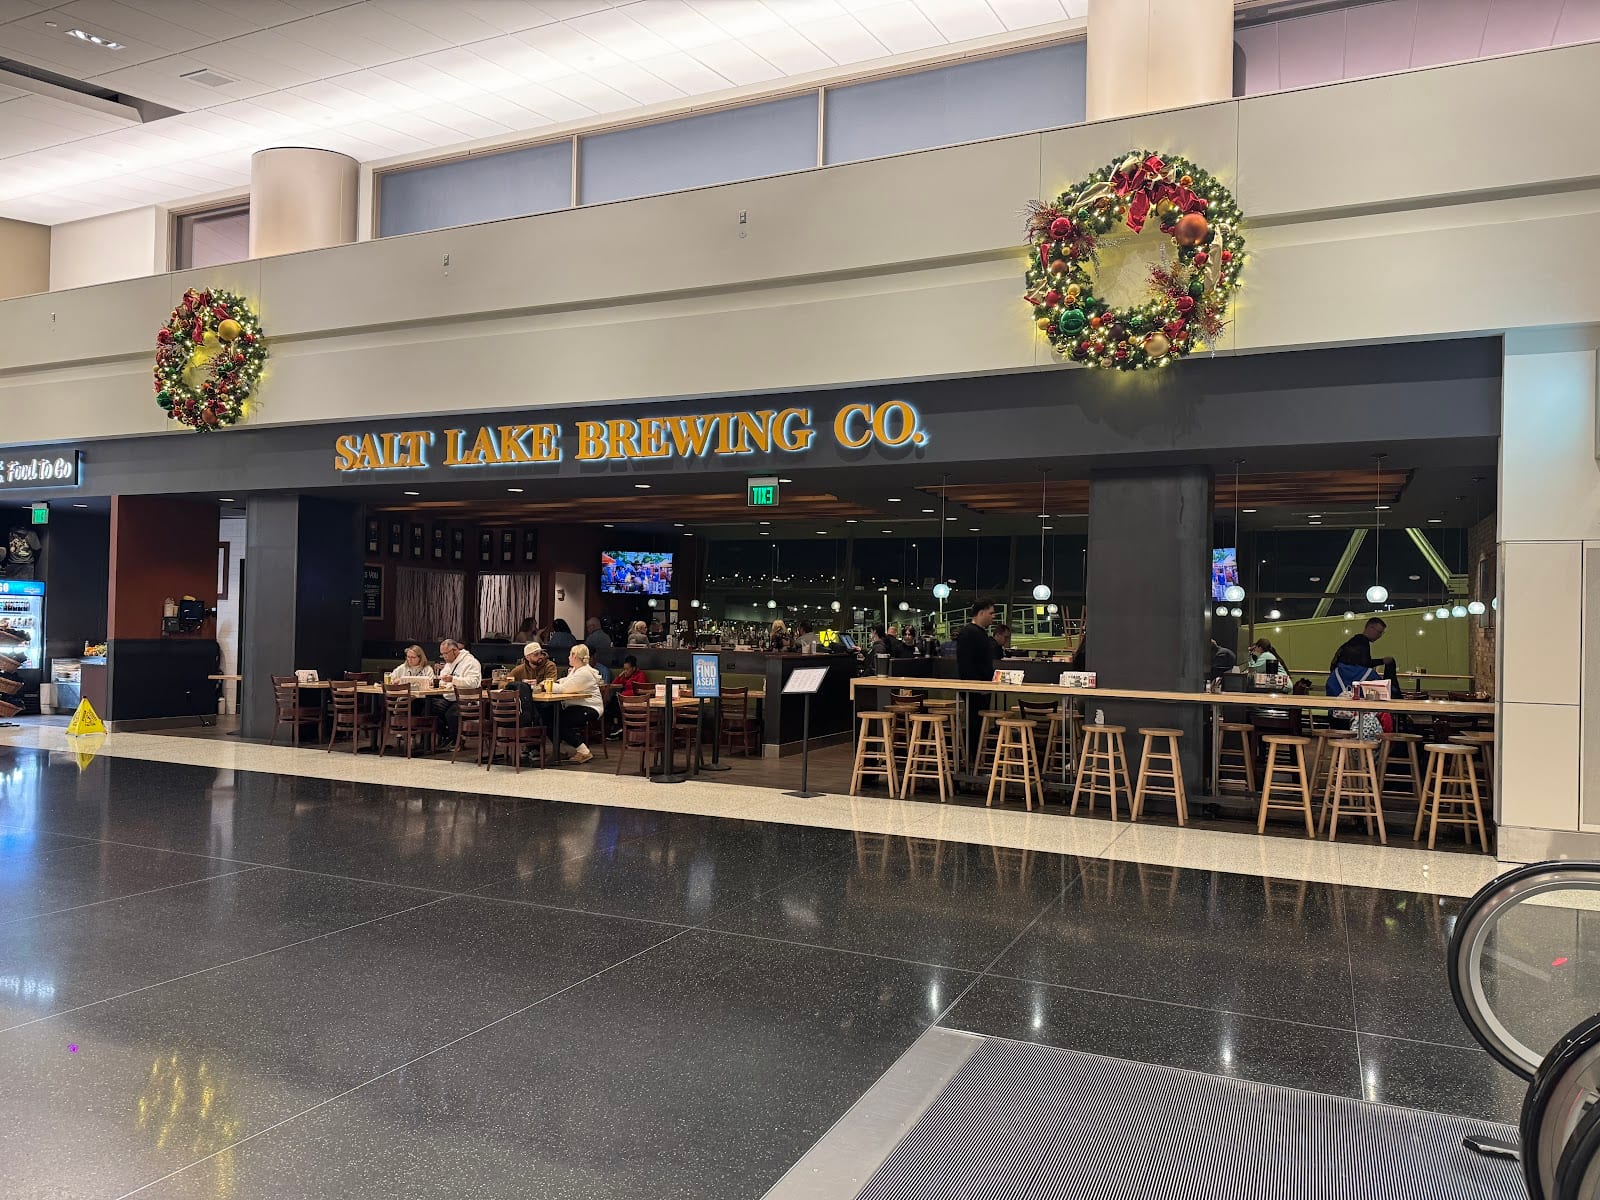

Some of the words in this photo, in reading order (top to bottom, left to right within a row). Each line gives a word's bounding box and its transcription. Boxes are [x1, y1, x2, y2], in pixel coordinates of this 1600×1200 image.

[334, 431, 431, 470] SALT
[443, 424, 561, 465] LAKE
[575, 407, 815, 460] BREWING
[833, 400, 928, 448] CO.
[7, 459, 38, 482] Food
[38, 458, 53, 480] To
[54, 457, 73, 479] Go
[696, 665, 717, 678] FIND
[696, 677, 701, 687] A
[702, 677, 716, 687] SEAT
